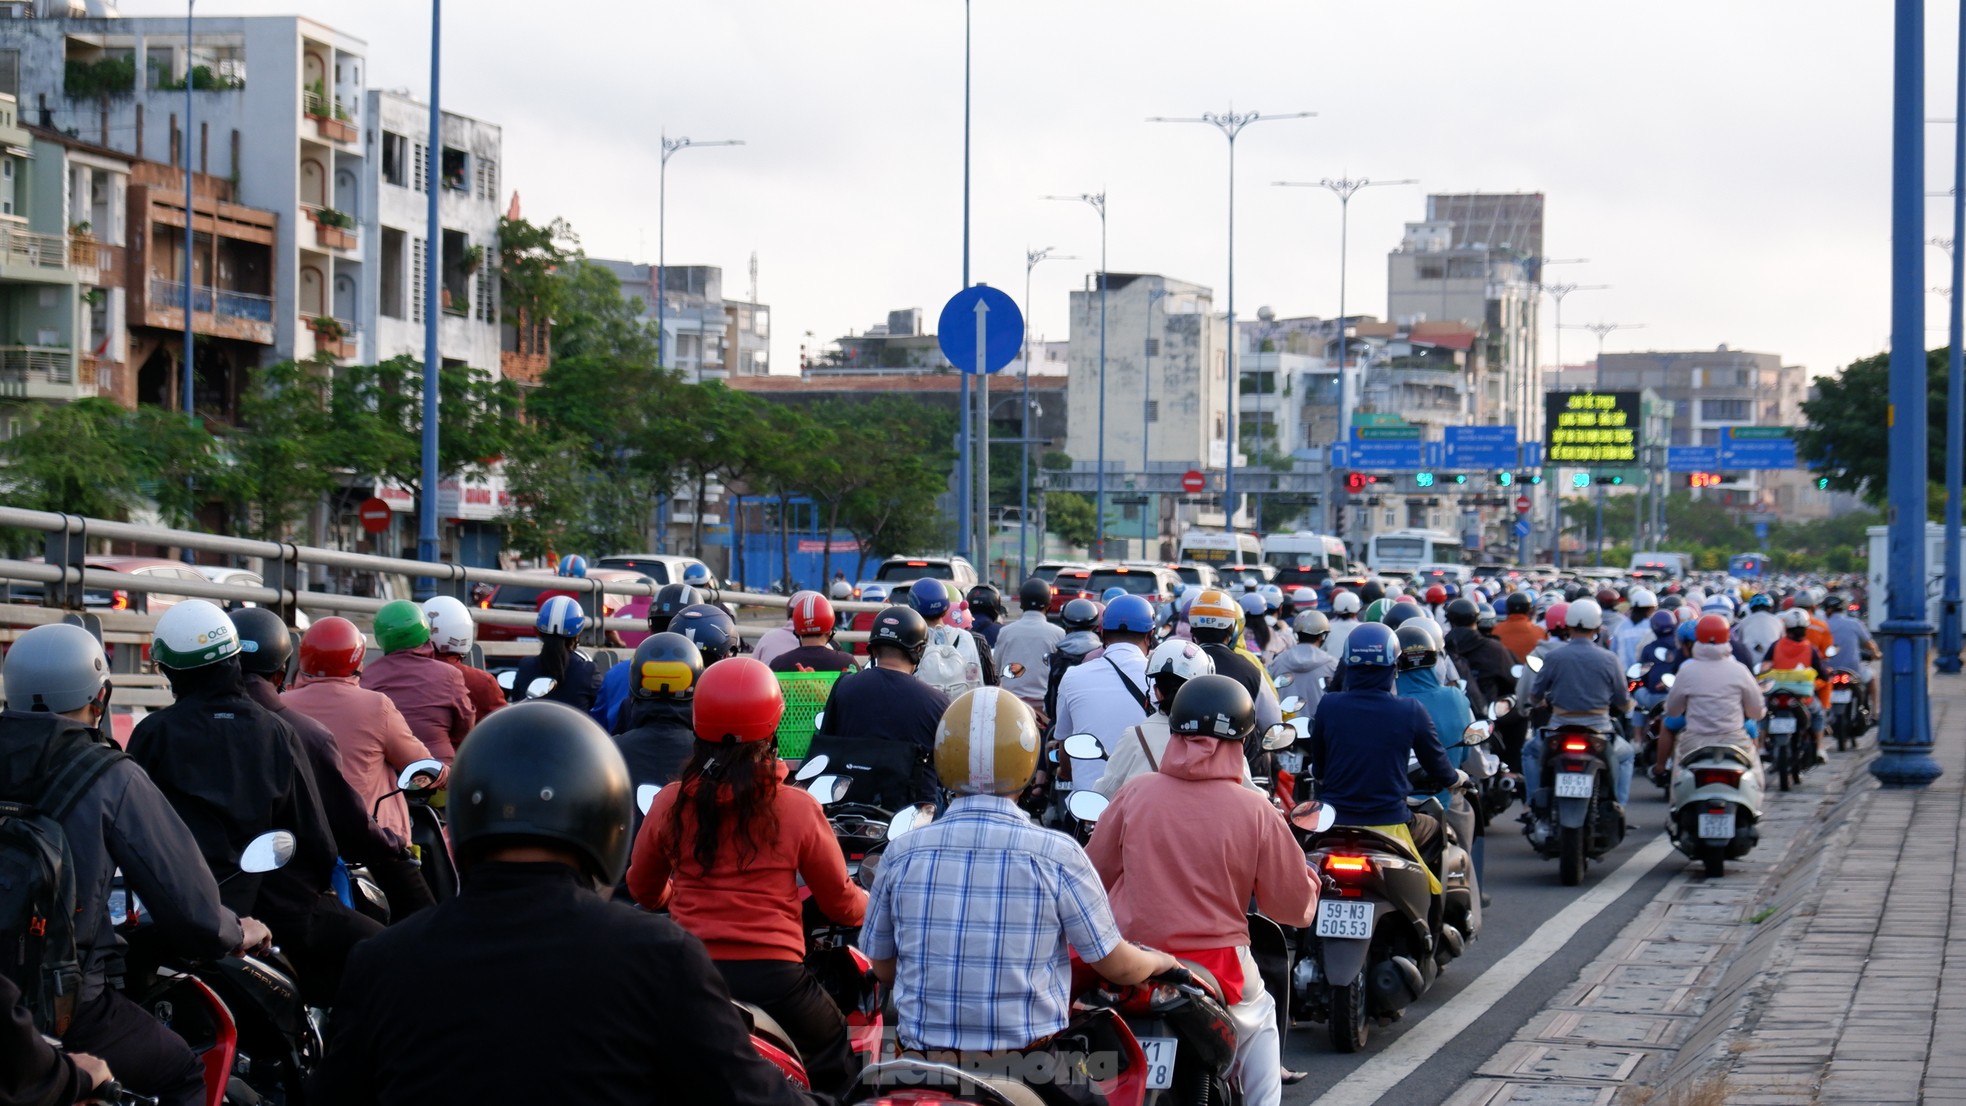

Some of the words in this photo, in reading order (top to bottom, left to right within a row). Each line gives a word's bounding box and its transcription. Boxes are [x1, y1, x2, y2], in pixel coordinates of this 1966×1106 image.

[208, 626, 227, 639] OCB
[1327, 904, 1365, 919] 59-N3
[1321, 920, 1367, 936] 505.53
